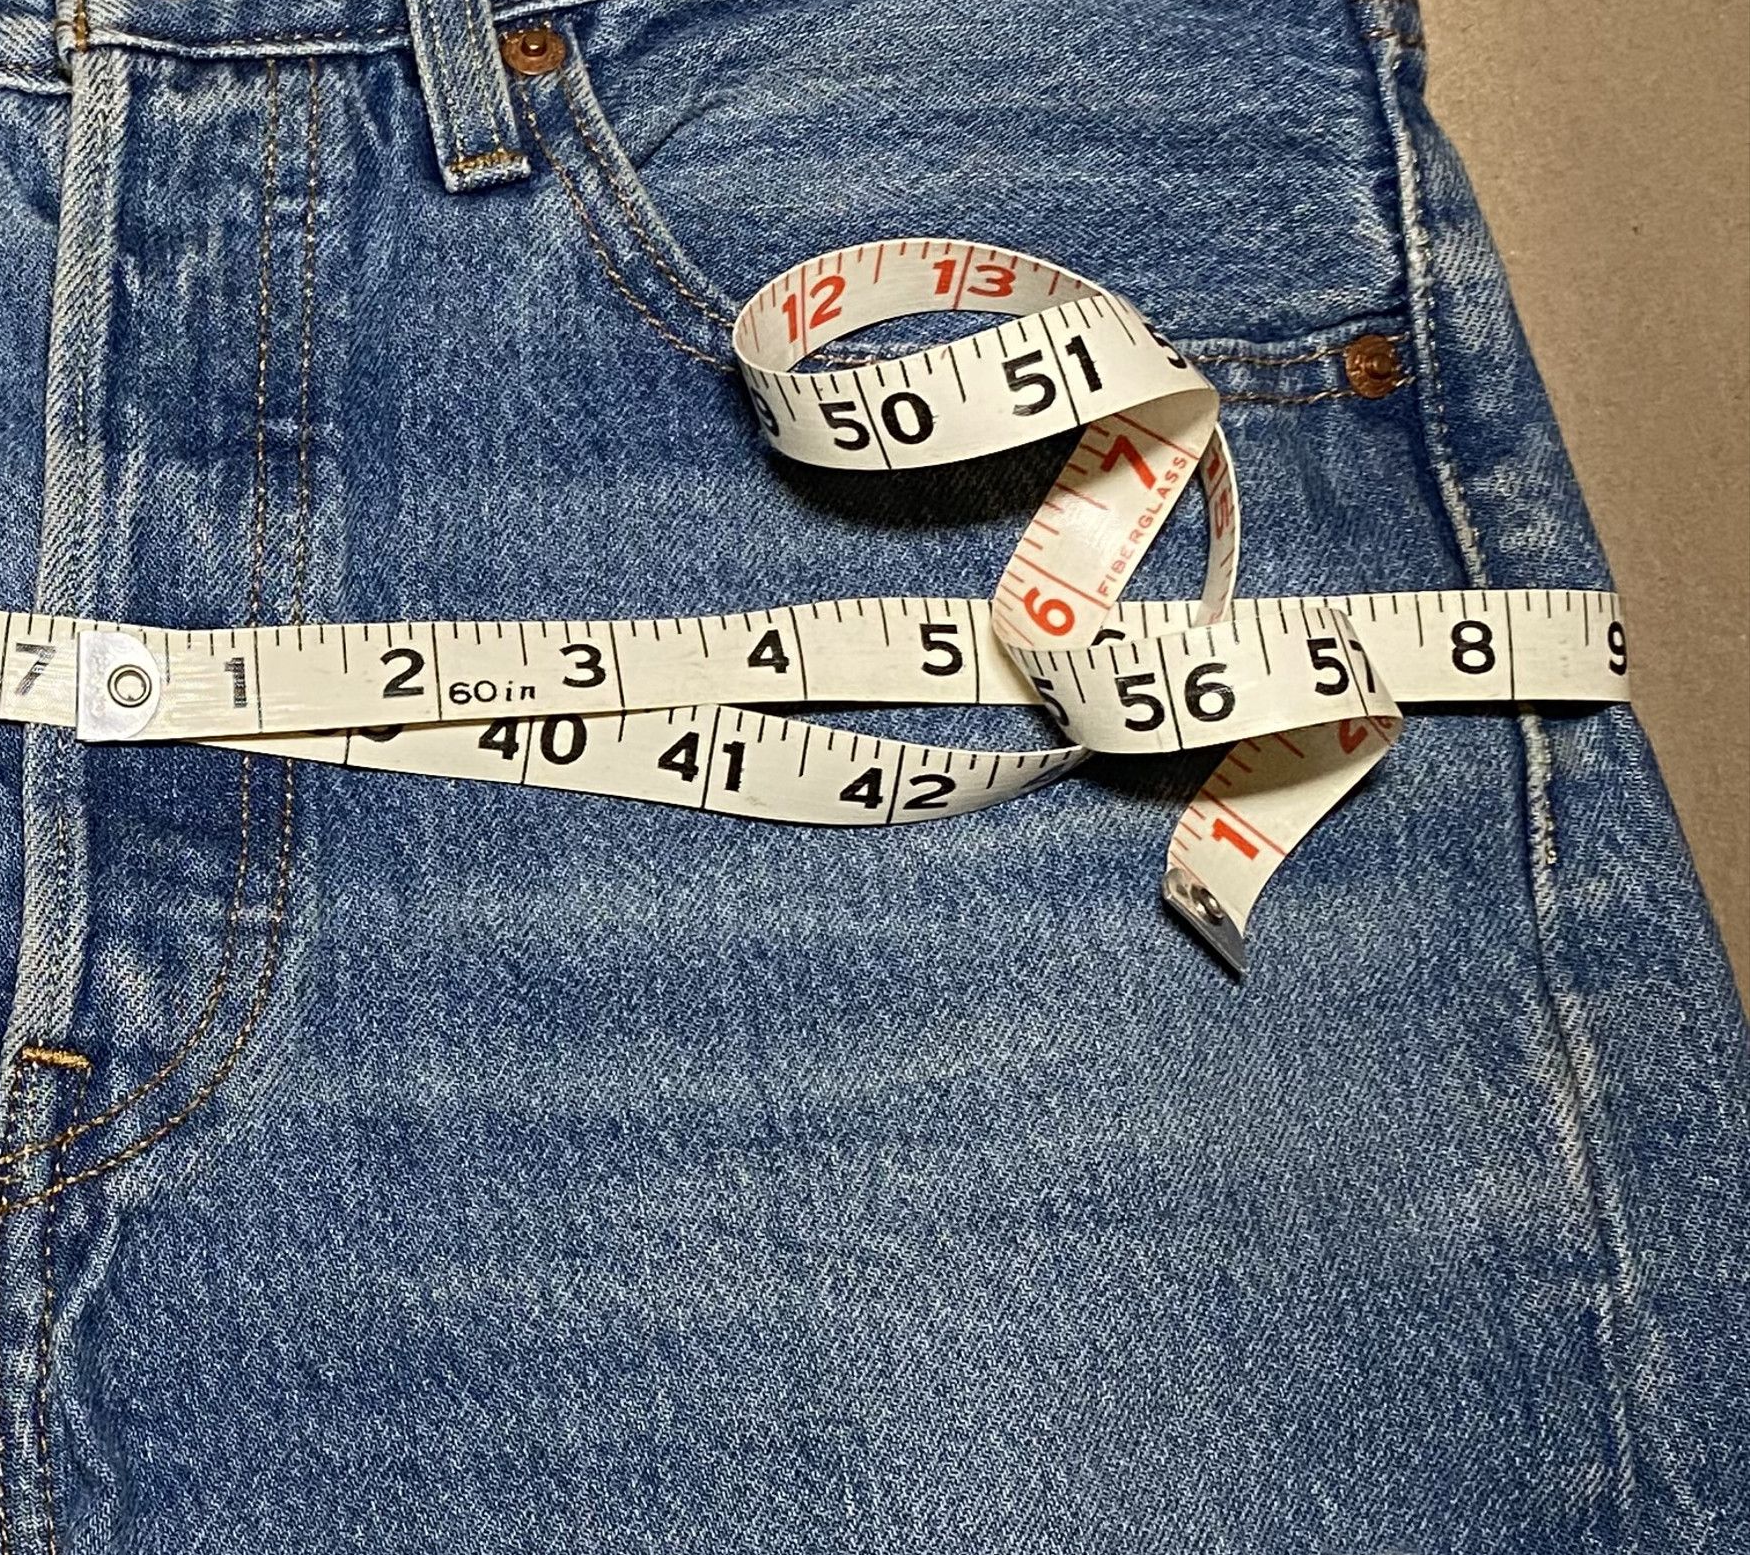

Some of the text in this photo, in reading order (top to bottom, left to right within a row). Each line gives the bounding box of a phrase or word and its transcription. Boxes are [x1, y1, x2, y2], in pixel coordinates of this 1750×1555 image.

[781, 258, 1016, 344] 12 13
[817, 392, 936, 451] 50
[1001, 334, 1103, 417] 51
[1100, 434, 1156, 490] 7
[1096, 455, 1188, 597] FIBERGLASS
[1023, 587, 1076, 637] 6
[222, 657, 247, 708] 1
[379, 648, 426, 698] 2
[558, 643, 607, 689] 3
[745, 629, 791, 674] 4
[918, 623, 964, 676] 5
[1450, 620, 1496, 674] 8
[1607, 620, 1628, 676] 9
[1114, 662, 1236, 732] 56
[1306, 637, 1376, 696] 57
[477, 714, 587, 766] 40
[656, 731, 745, 792] 41
[838, 767, 957, 811] 42
[1210, 817, 1260, 861] 1
